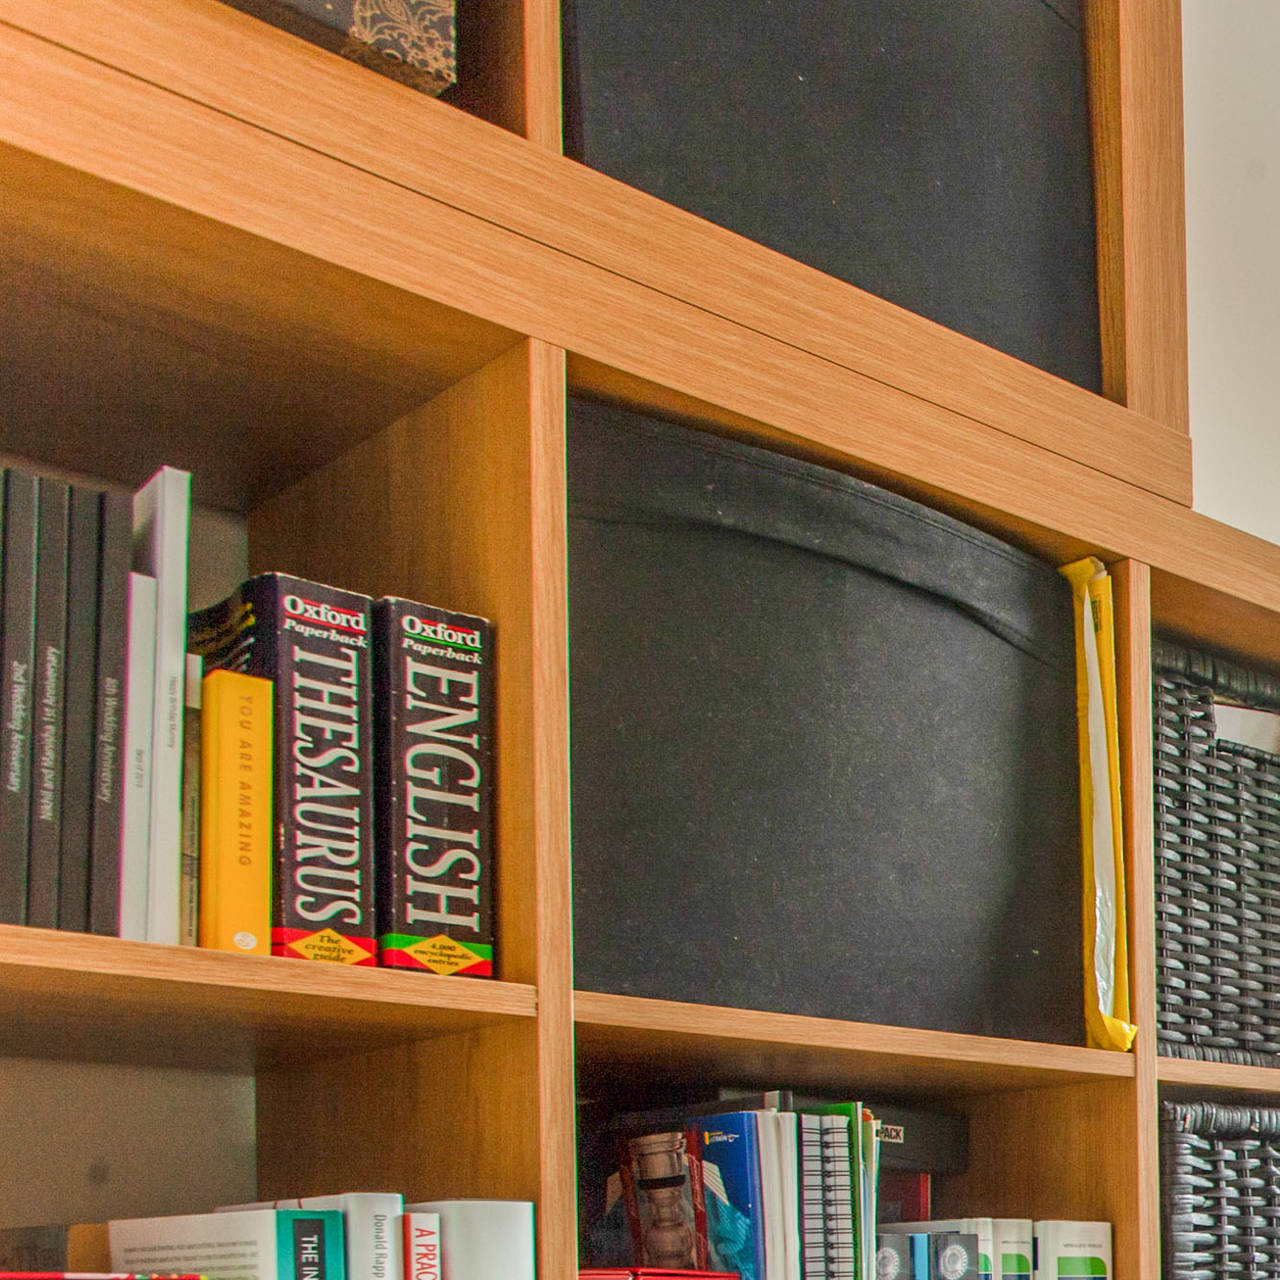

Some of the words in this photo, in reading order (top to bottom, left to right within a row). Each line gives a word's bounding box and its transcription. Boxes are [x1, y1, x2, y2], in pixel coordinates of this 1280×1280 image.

[282, 595, 367, 632] Oxford
[283, 618, 368, 648] Paperback
[401, 615, 482, 648] Oxford
[402, 638, 482, 665] Paperback
[240, 696, 254, 731] YOU
[239, 742, 253, 774] ARE
[293, 645, 363, 926] THESAURUS
[404, 656, 482, 933] ENGLISH
[238, 781, 253, 867] AMAZING
[305, 943, 354, 955] creative
[413, 947, 472, 962] encyclopedic
[373, 1214, 388, 1250] Donald
[415, 1227, 435, 1239] A
[300, 1235, 318, 1263] THE
[372, 1252, 387, 1279] Rapp
